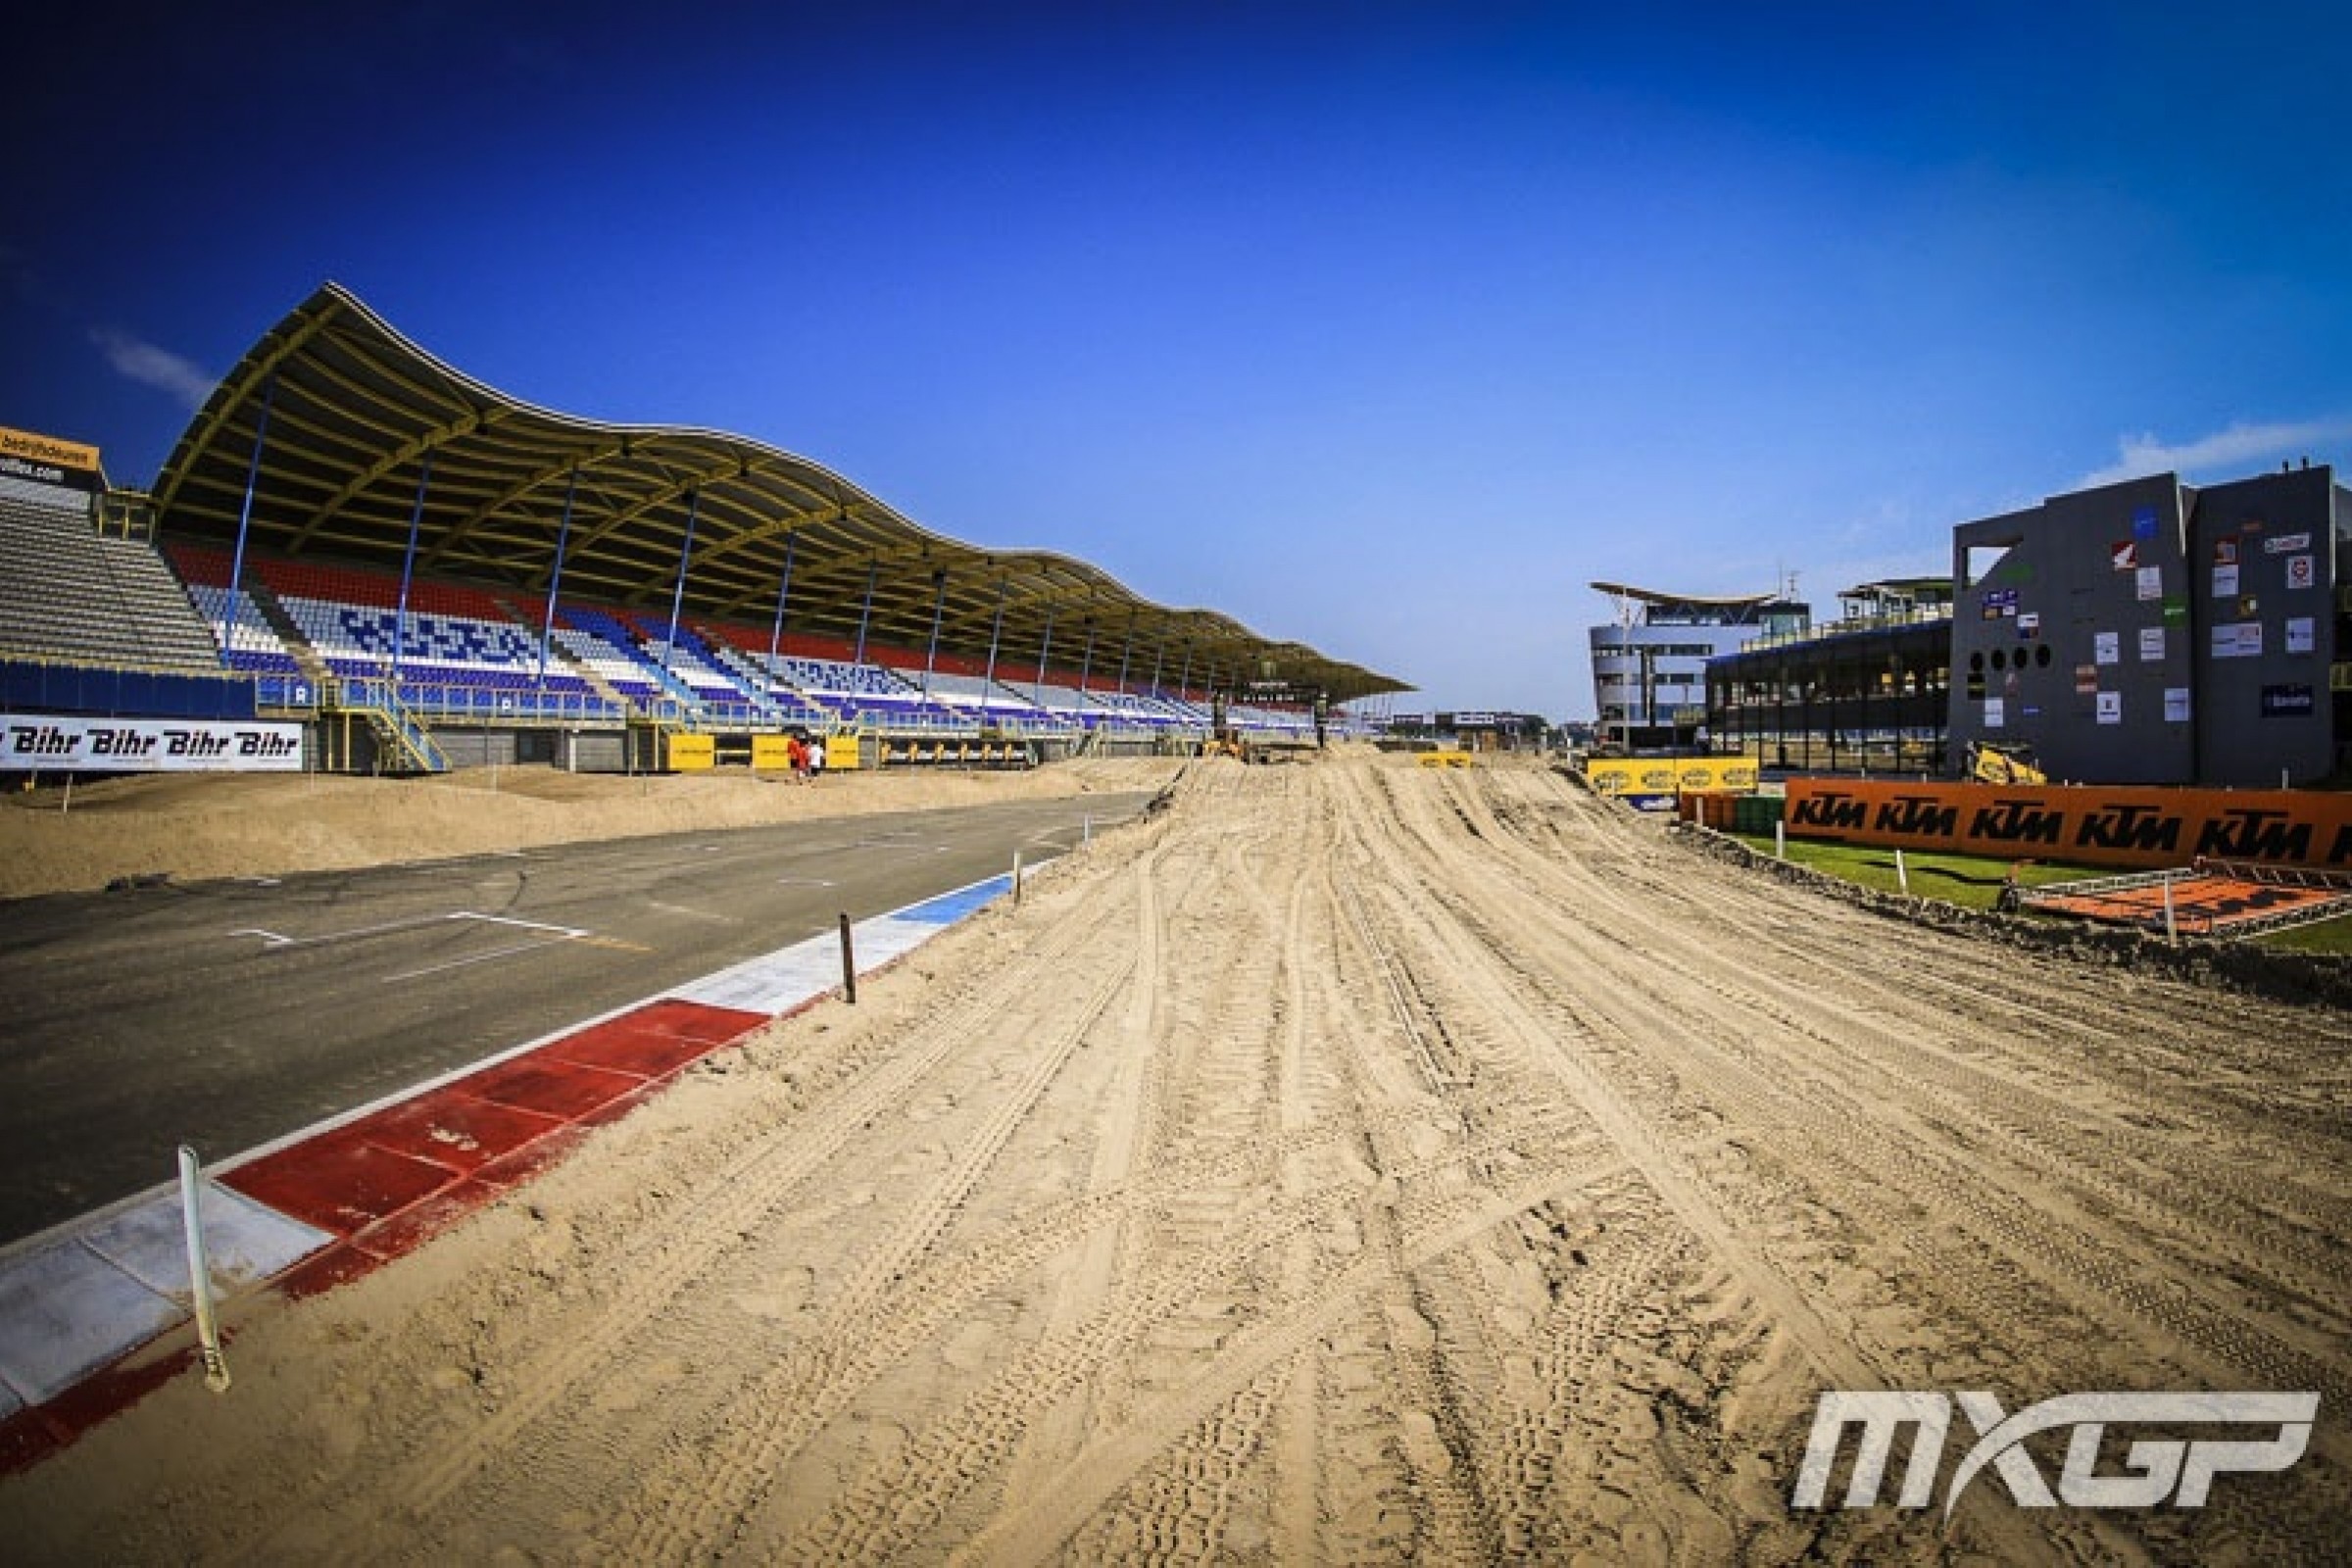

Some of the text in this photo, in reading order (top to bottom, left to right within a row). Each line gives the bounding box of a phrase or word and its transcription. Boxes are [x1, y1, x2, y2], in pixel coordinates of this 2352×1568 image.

[10, 726, 81, 754] Bihr
[87, 729, 158, 755] Bihr
[164, 729, 231, 756] Bihr
[234, 731, 300, 756] Bihr
[1790, 791, 1868, 827] KTM
[1876, 796, 1959, 835] KTM
[1969, 800, 2062, 844] KTM
[2077, 806, 2182, 851] KTM
[2195, 808, 2313, 859] KTM
